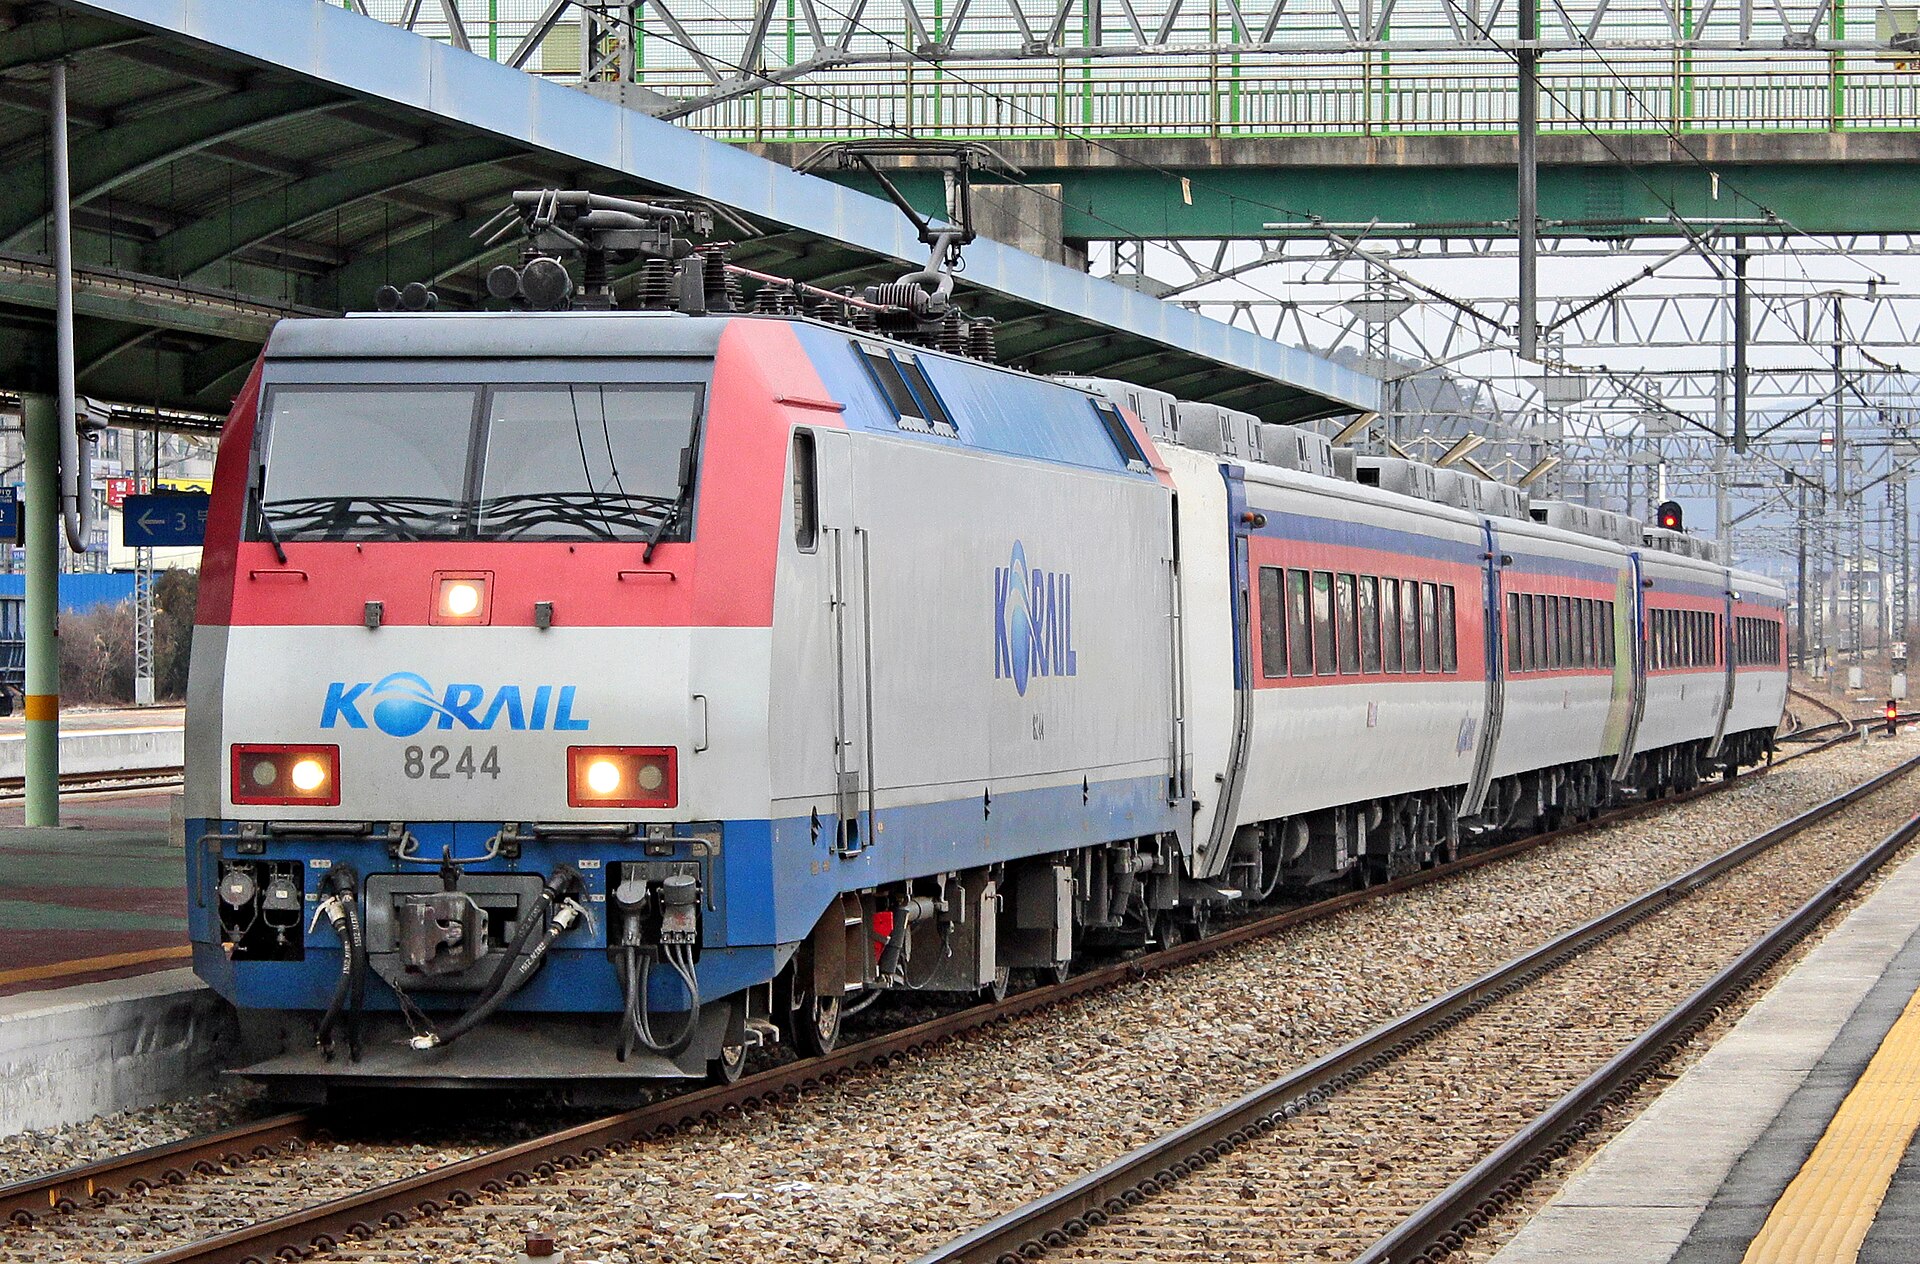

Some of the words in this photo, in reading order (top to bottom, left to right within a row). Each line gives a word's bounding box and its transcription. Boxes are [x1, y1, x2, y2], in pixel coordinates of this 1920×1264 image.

[174, 512, 187, 532] 3
[995, 539, 1077, 697] KORAIL
[320, 671, 590, 738] KORAIL
[404, 745, 501, 780] 8244
